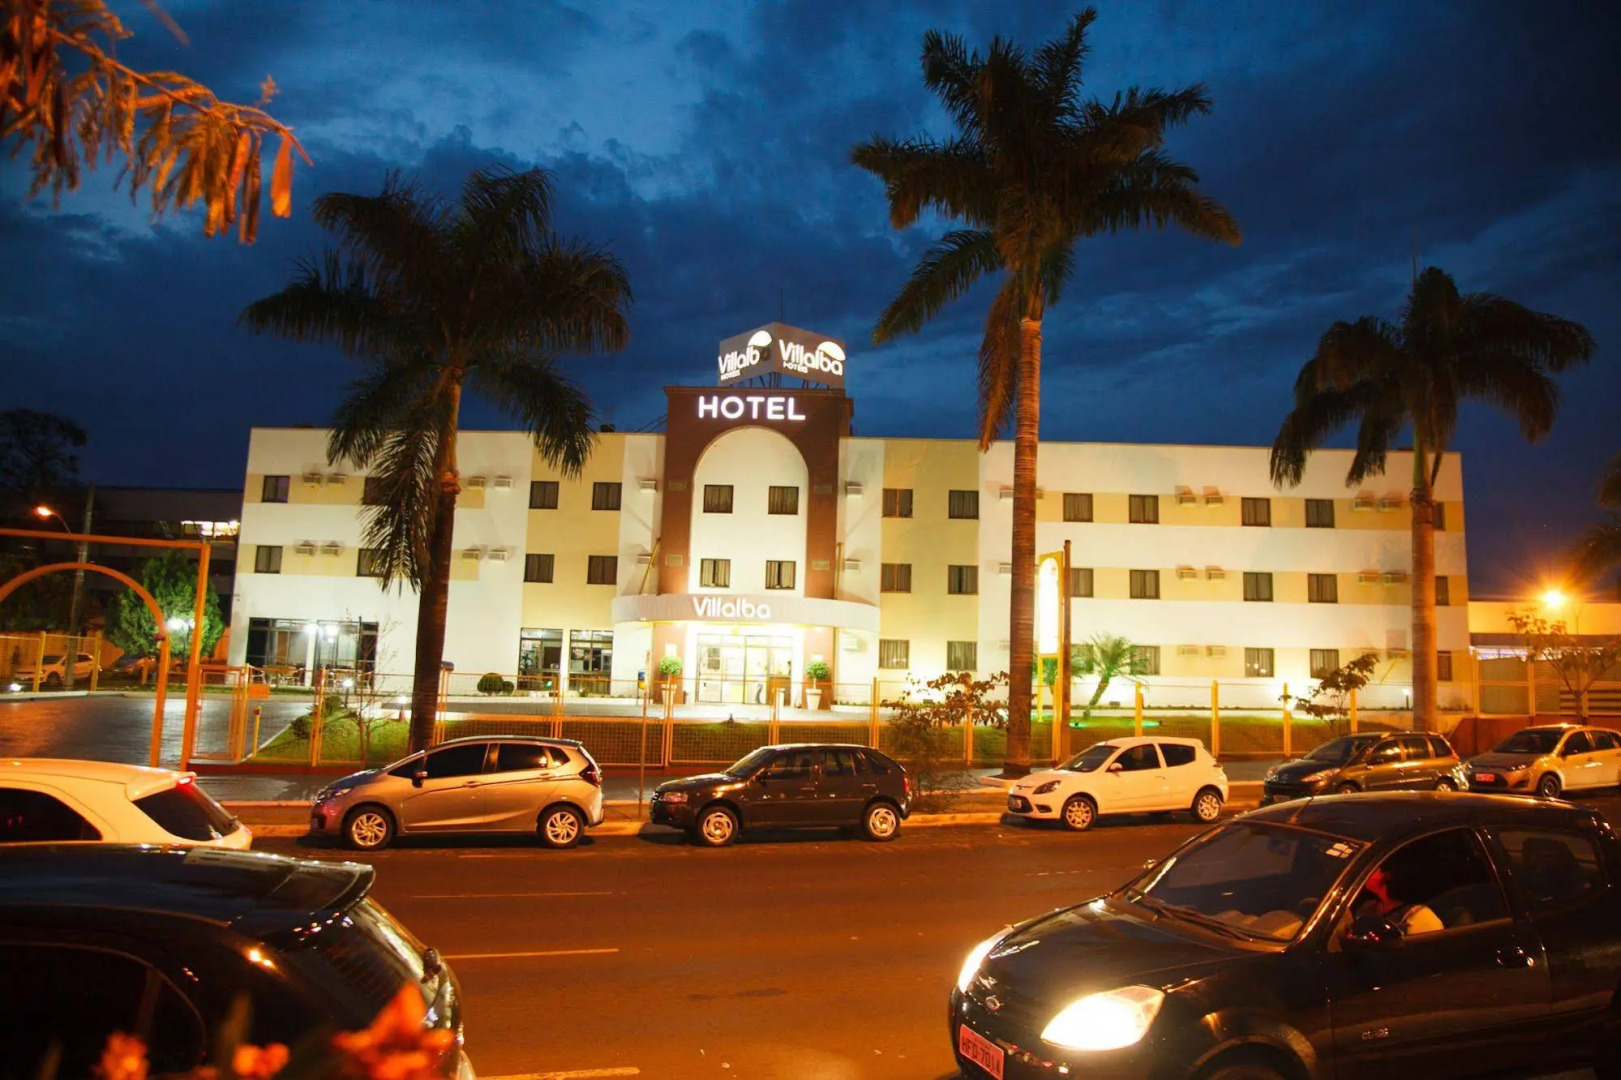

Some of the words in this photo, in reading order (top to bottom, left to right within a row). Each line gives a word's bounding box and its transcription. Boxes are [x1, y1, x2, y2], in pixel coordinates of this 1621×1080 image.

[779, 339, 843, 376] Villalba
[698, 395, 806, 421] HOTEL
[693, 597, 771, 620] Villalba
